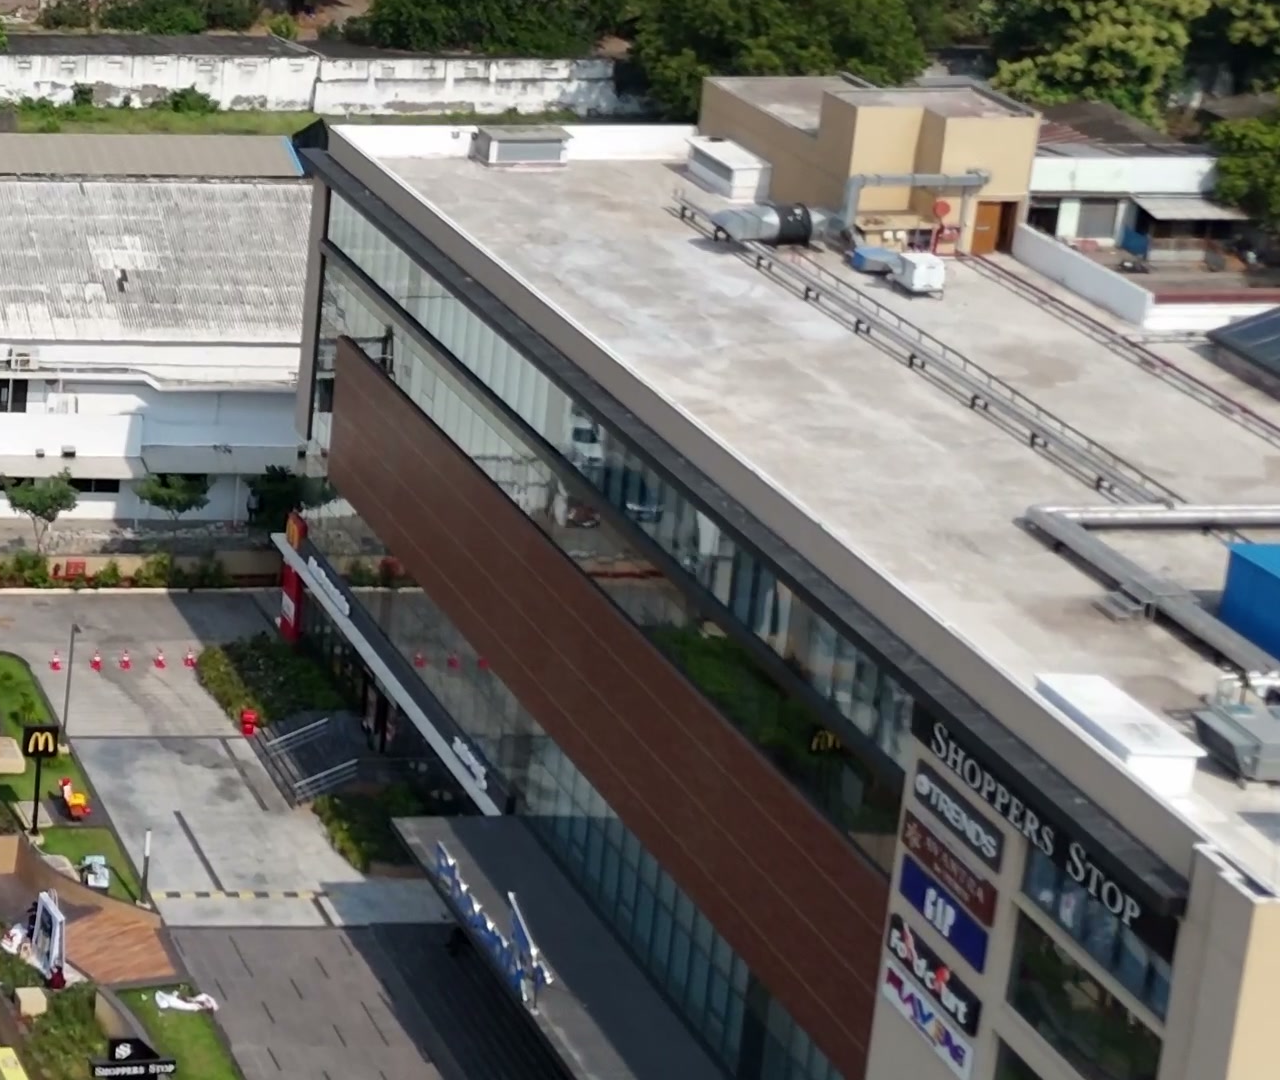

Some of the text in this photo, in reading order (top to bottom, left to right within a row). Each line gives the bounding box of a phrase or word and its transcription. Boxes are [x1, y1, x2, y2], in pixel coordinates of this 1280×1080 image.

[928, 782, 997, 858] TRENDS
[930, 721, 1141, 926] SHOPPERS STOP
